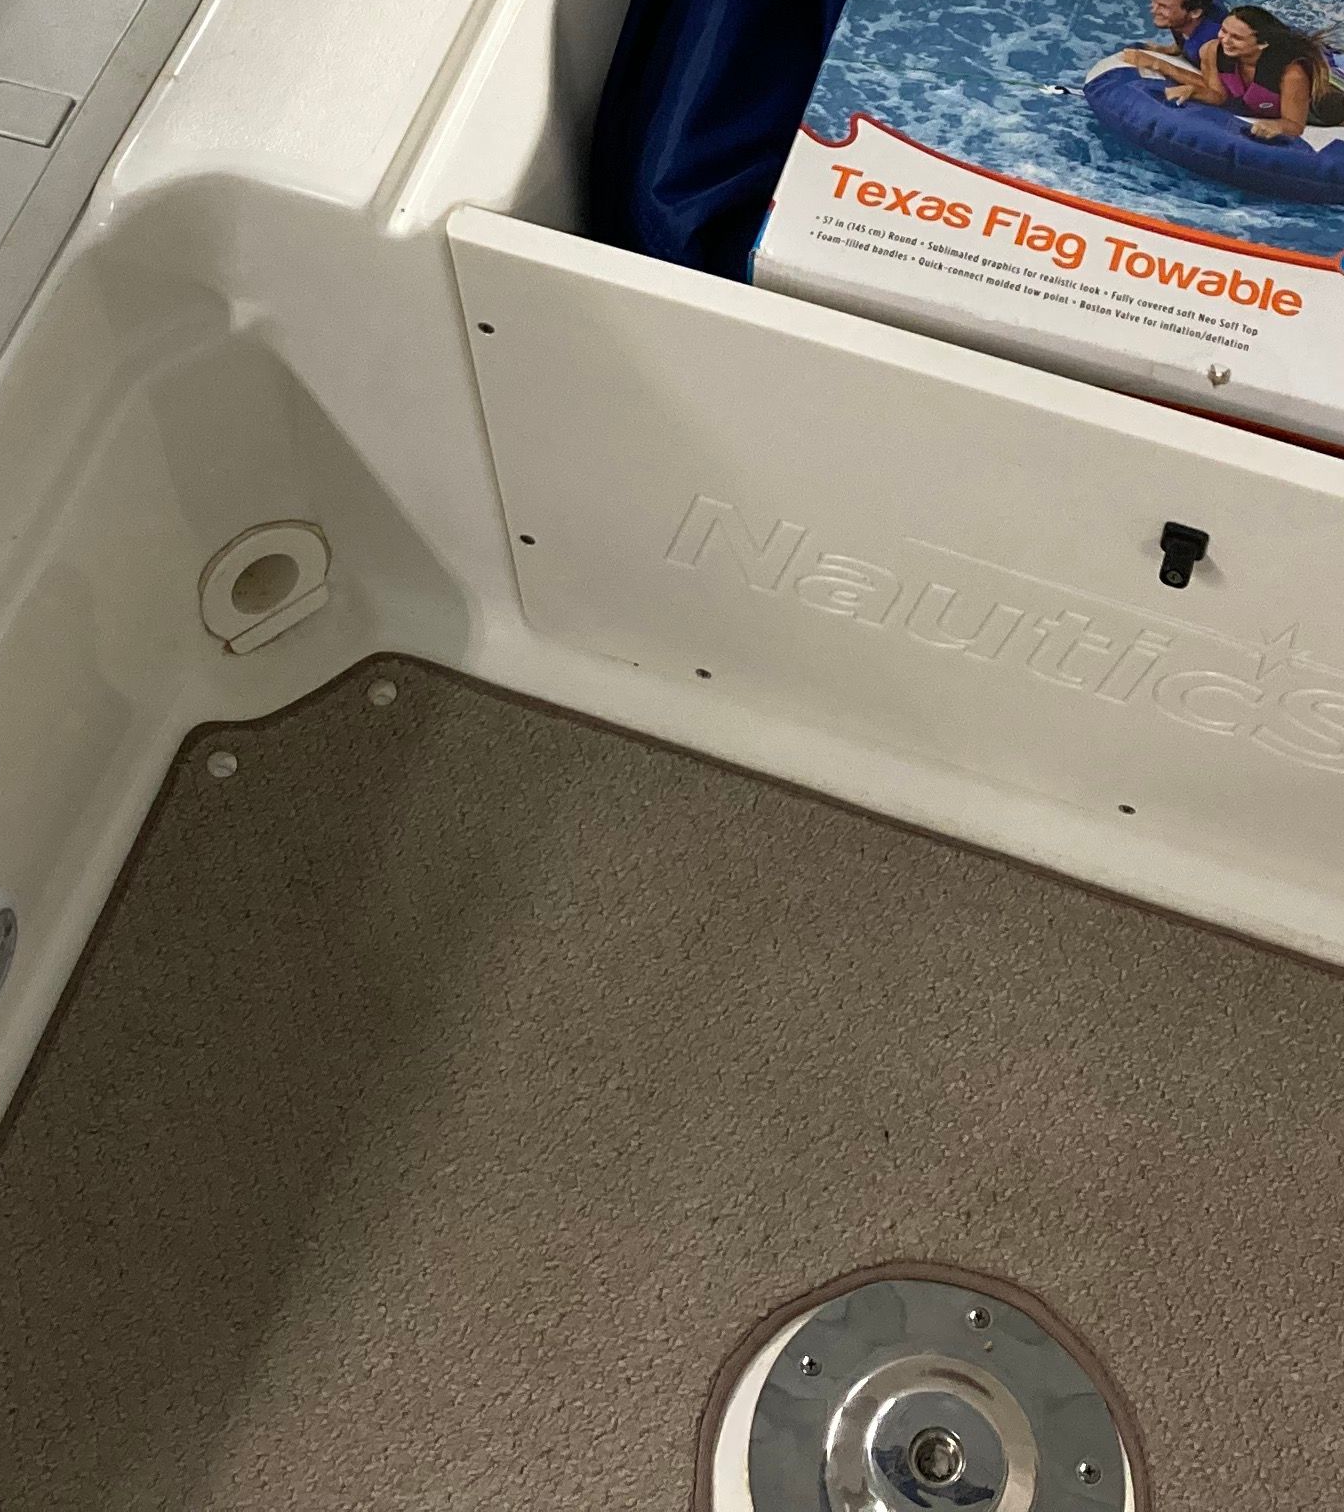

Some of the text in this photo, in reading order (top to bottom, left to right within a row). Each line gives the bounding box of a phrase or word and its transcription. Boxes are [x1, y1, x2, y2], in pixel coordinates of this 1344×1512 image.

[816, 230, 1250, 352] Foam-filled handles Quick-connect molded tow point Boston Valve for inflation/deflation
[822, 215, 1259, 337] 57 in (145 cm) Round Sublimated graphics for realistic look Fully covered soft Neo Soft Top
[830, 164, 1304, 318] Texas Flag Towable
